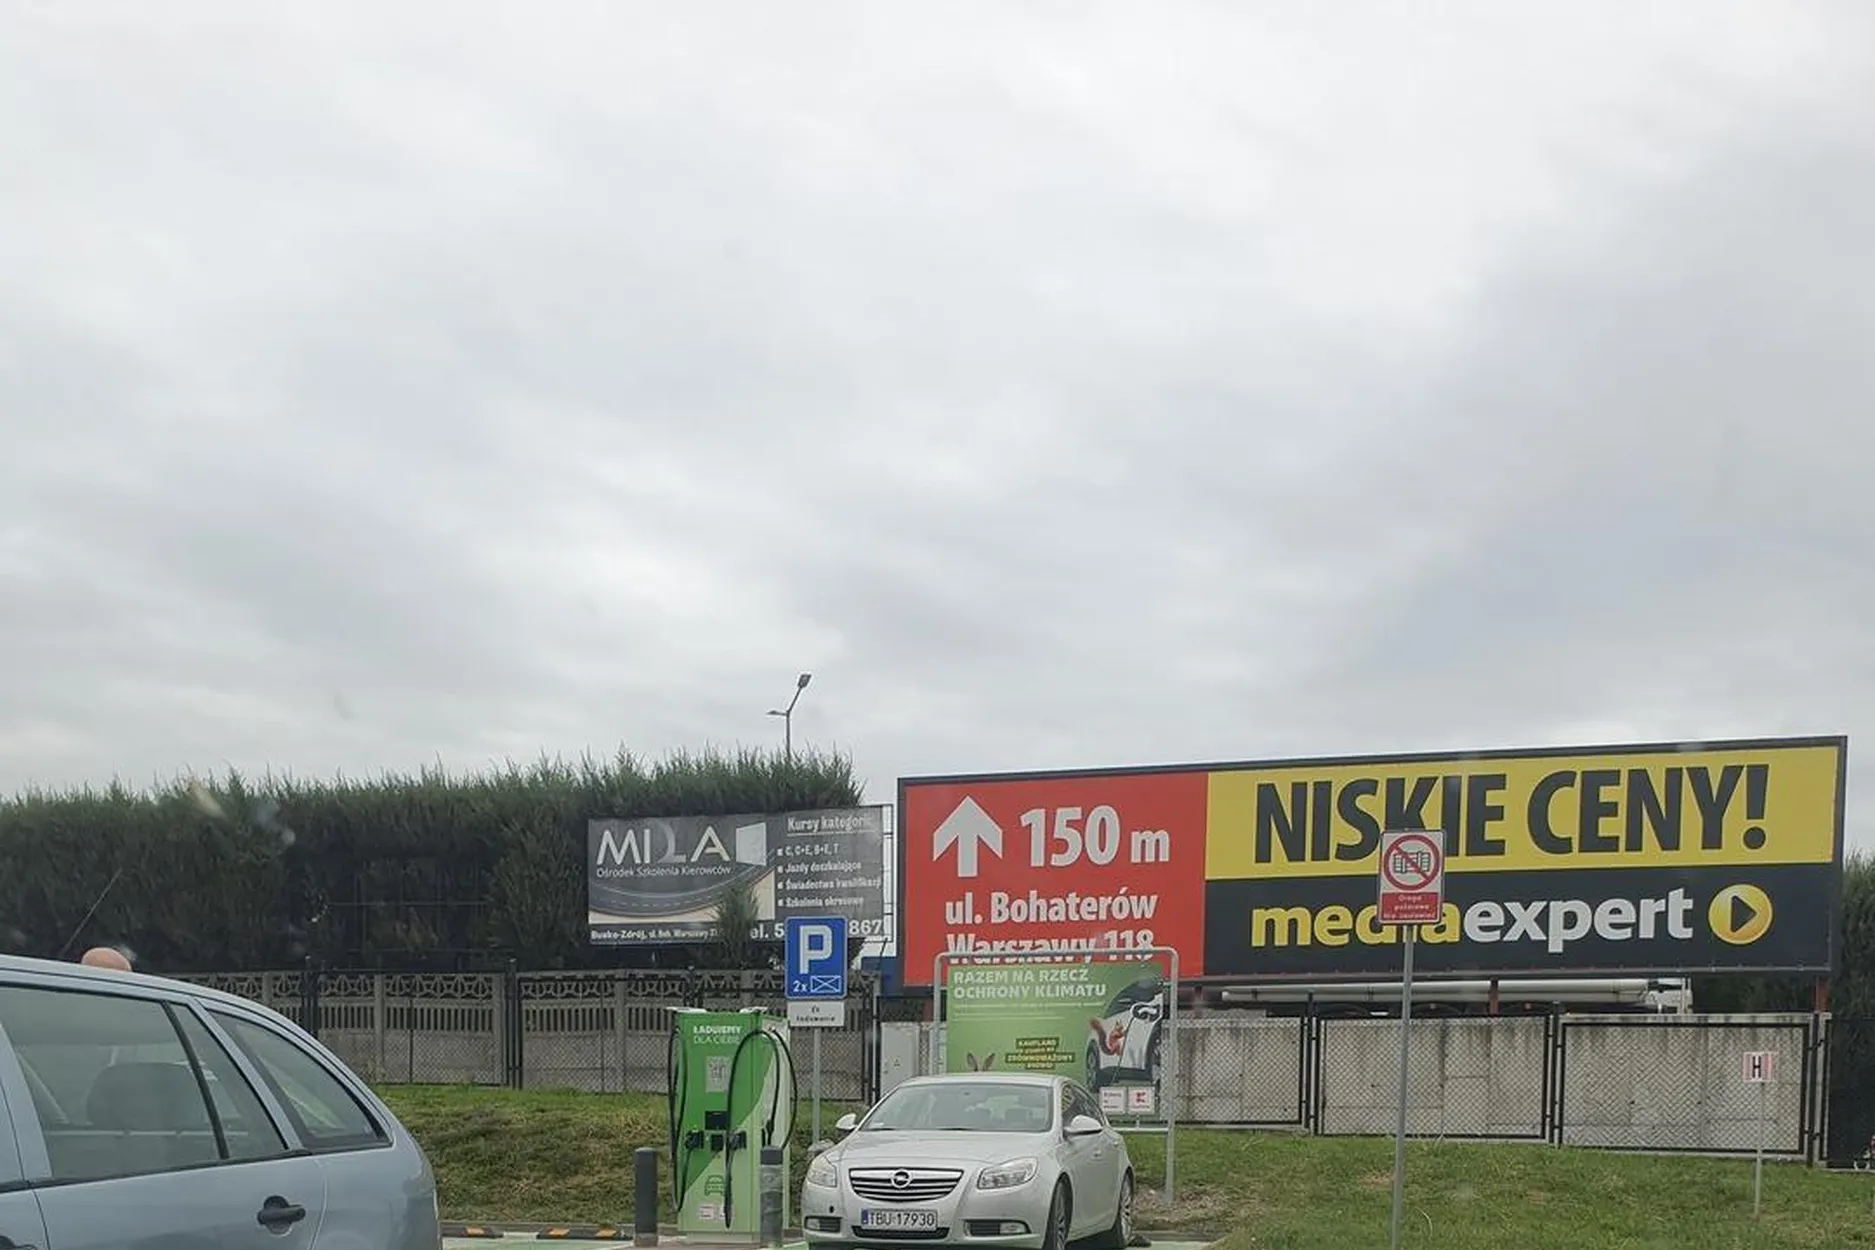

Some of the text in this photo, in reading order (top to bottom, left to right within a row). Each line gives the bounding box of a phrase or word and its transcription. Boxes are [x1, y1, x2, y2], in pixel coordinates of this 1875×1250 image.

[1254, 763, 1770, 864] NISKIE CENY!
[1020, 805, 1171, 867] 150 m
[945, 887, 1158, 925] ul. Bohaterów
[799, 924, 833, 974] P
[947, 930, 1155, 964] Warszawy 118
[953, 968, 1090, 984] RAZEM NA RZECZ
[954, 983, 1107, 999] OCHRONY KLIMATU
[1752, 1055, 1762, 1079] H
